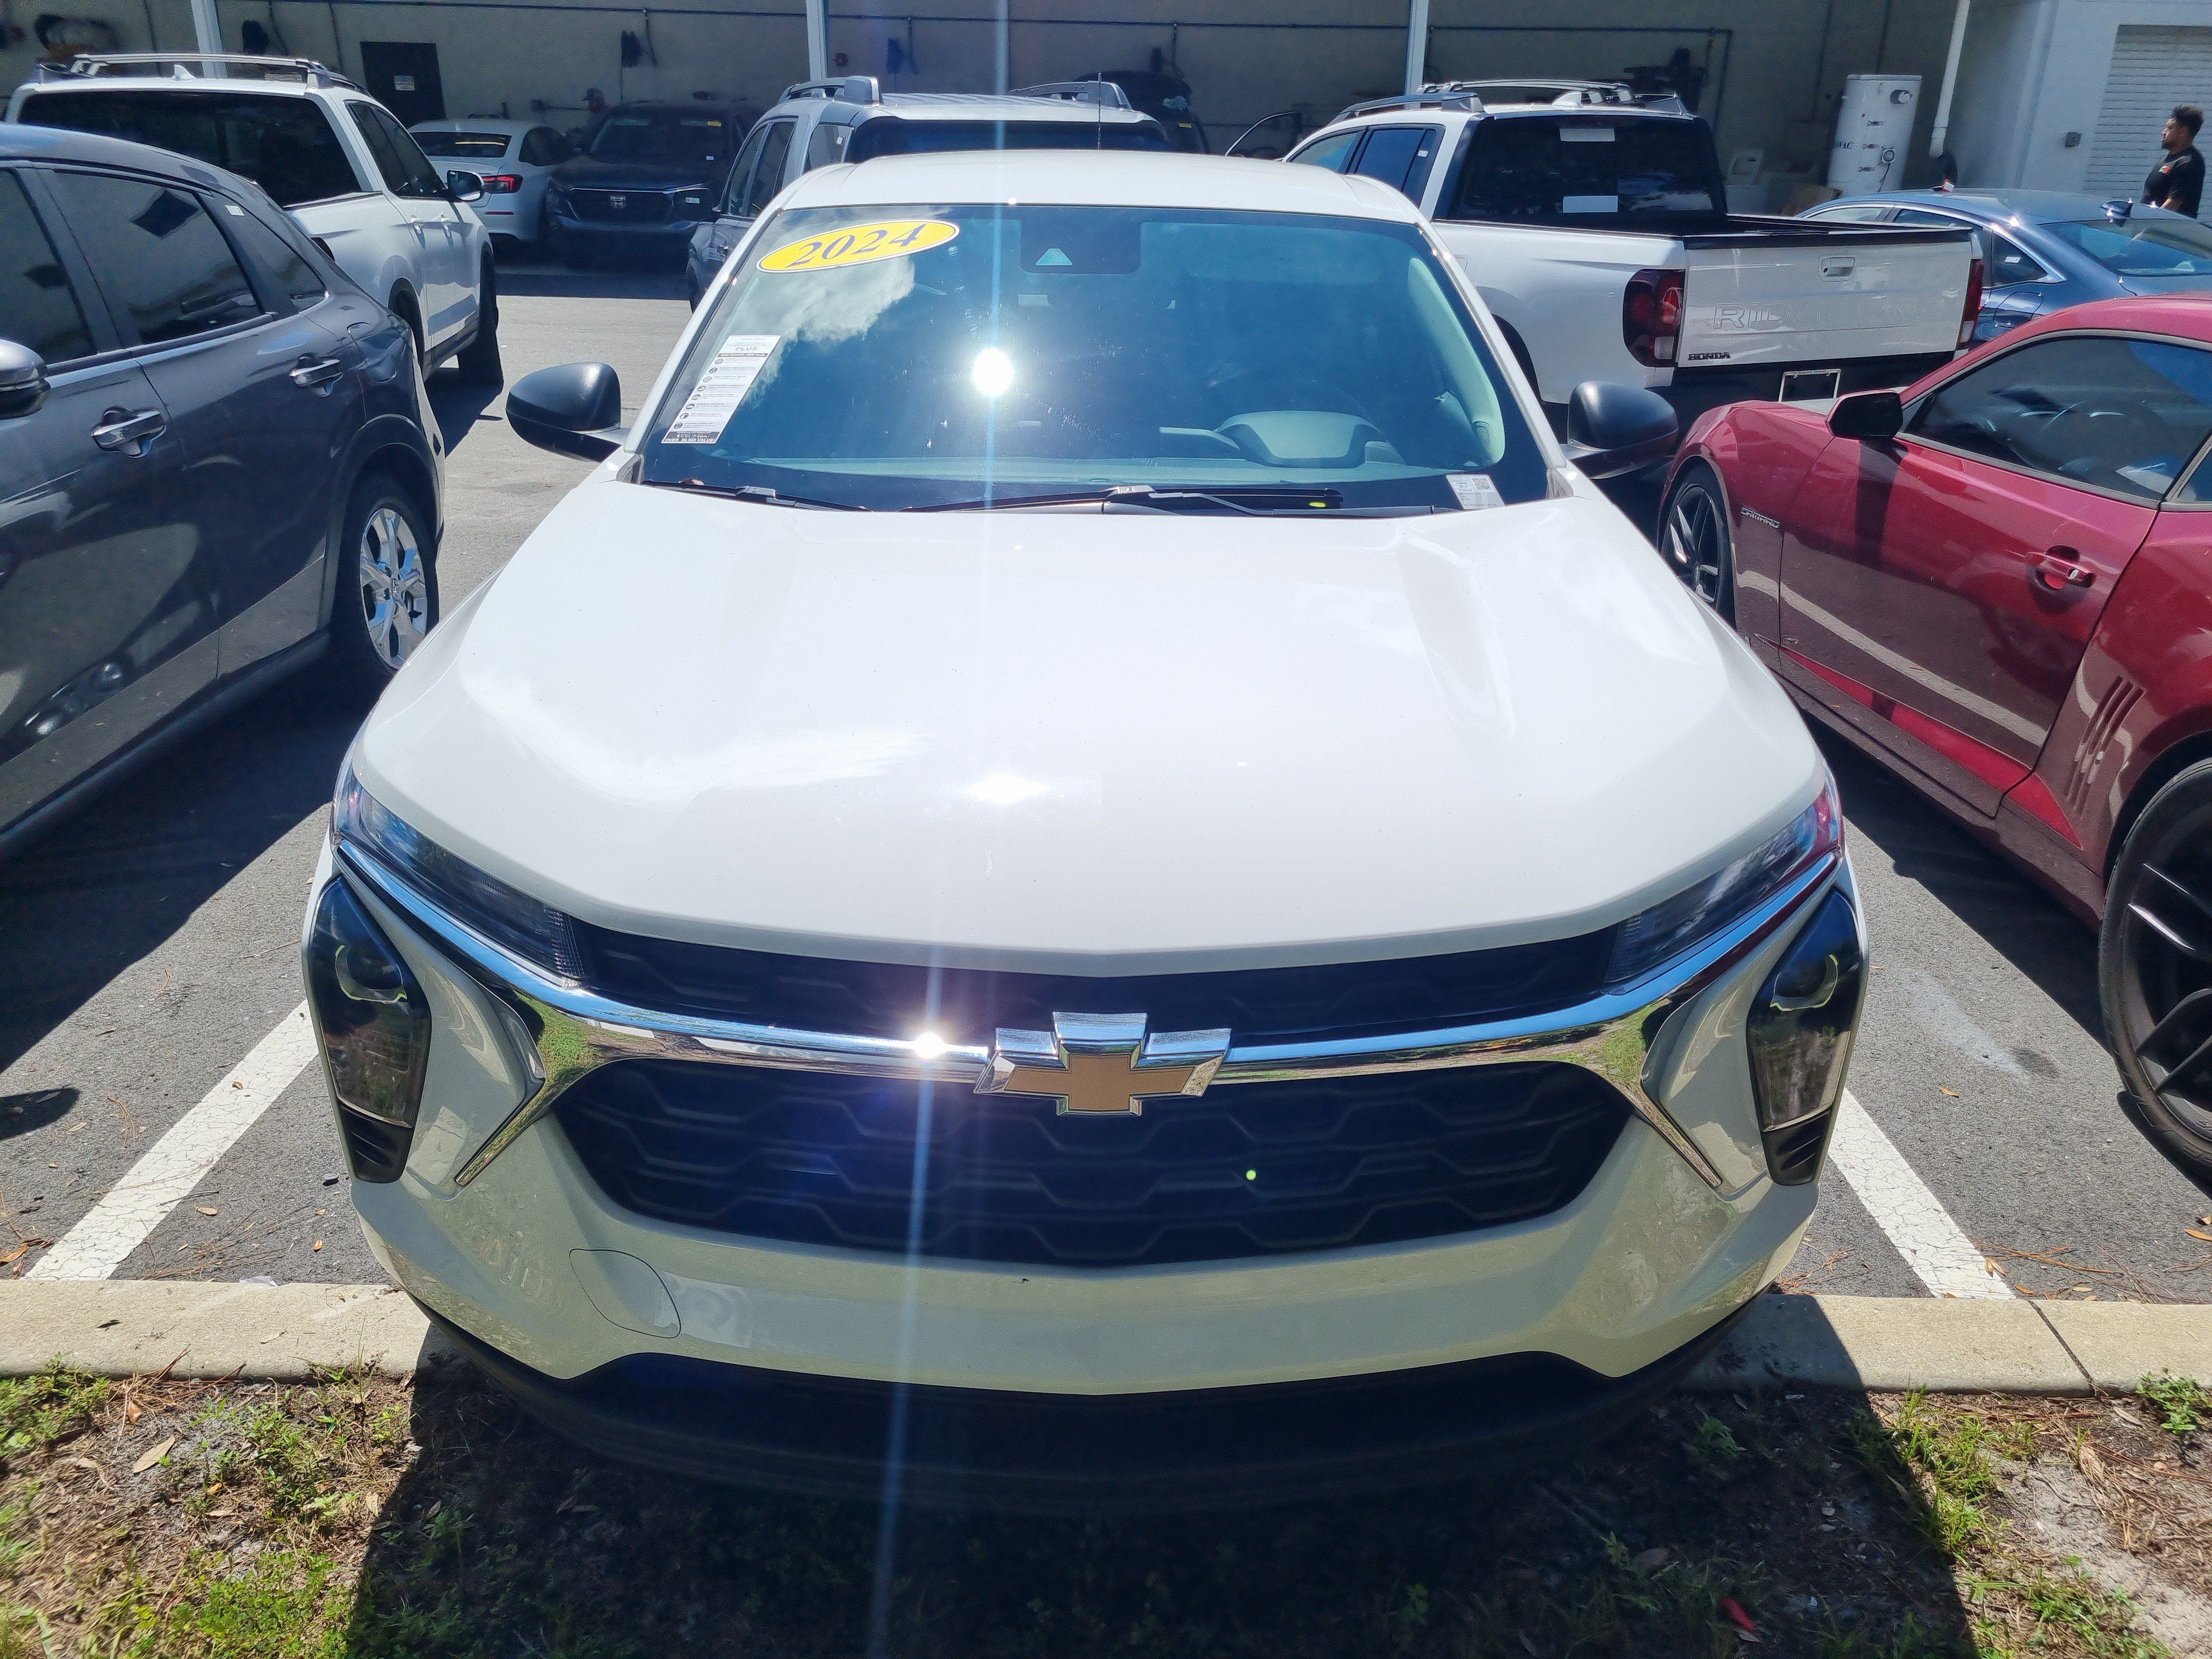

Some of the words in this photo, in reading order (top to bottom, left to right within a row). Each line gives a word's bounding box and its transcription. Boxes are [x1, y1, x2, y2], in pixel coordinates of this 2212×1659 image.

[784, 223, 927, 268] 2024
[1688, 352, 1731, 361] HONDA
[1741, 507, 1780, 529] CAMARO
